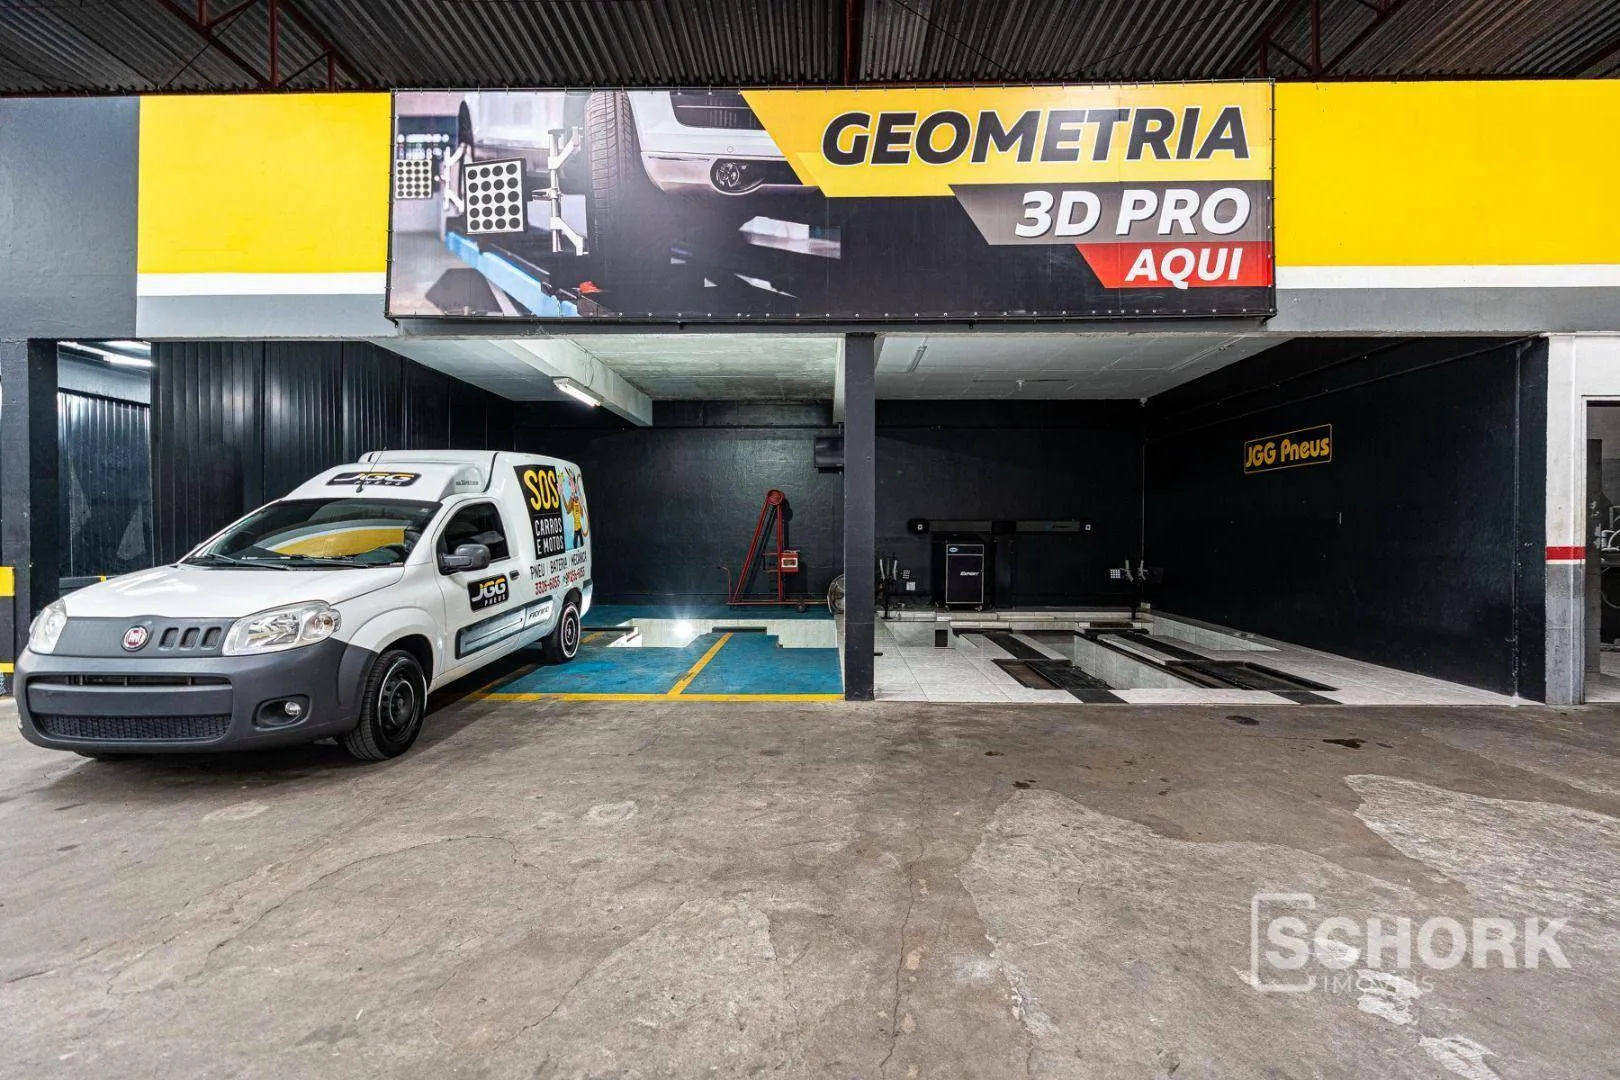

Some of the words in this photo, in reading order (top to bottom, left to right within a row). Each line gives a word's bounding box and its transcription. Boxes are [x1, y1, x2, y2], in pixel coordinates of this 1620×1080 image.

[822, 106, 1250, 165] GEOMETRIA
[1014, 190, 1102, 236] 3D
[1115, 187, 1252, 235] PRO
[1125, 248, 1243, 289] AQUI
[1245, 441, 1277, 467] JGG
[1281, 438, 1330, 462] Pneus
[334, 472, 415, 482] JGG
[523, 469, 560, 511] SOS
[534, 517, 563, 537] CARROS
[537, 538, 543, 555] E
[543, 535, 565, 553] MOTOS
[530, 563, 546, 580] PNEU
[471, 577, 506, 602] JGG
